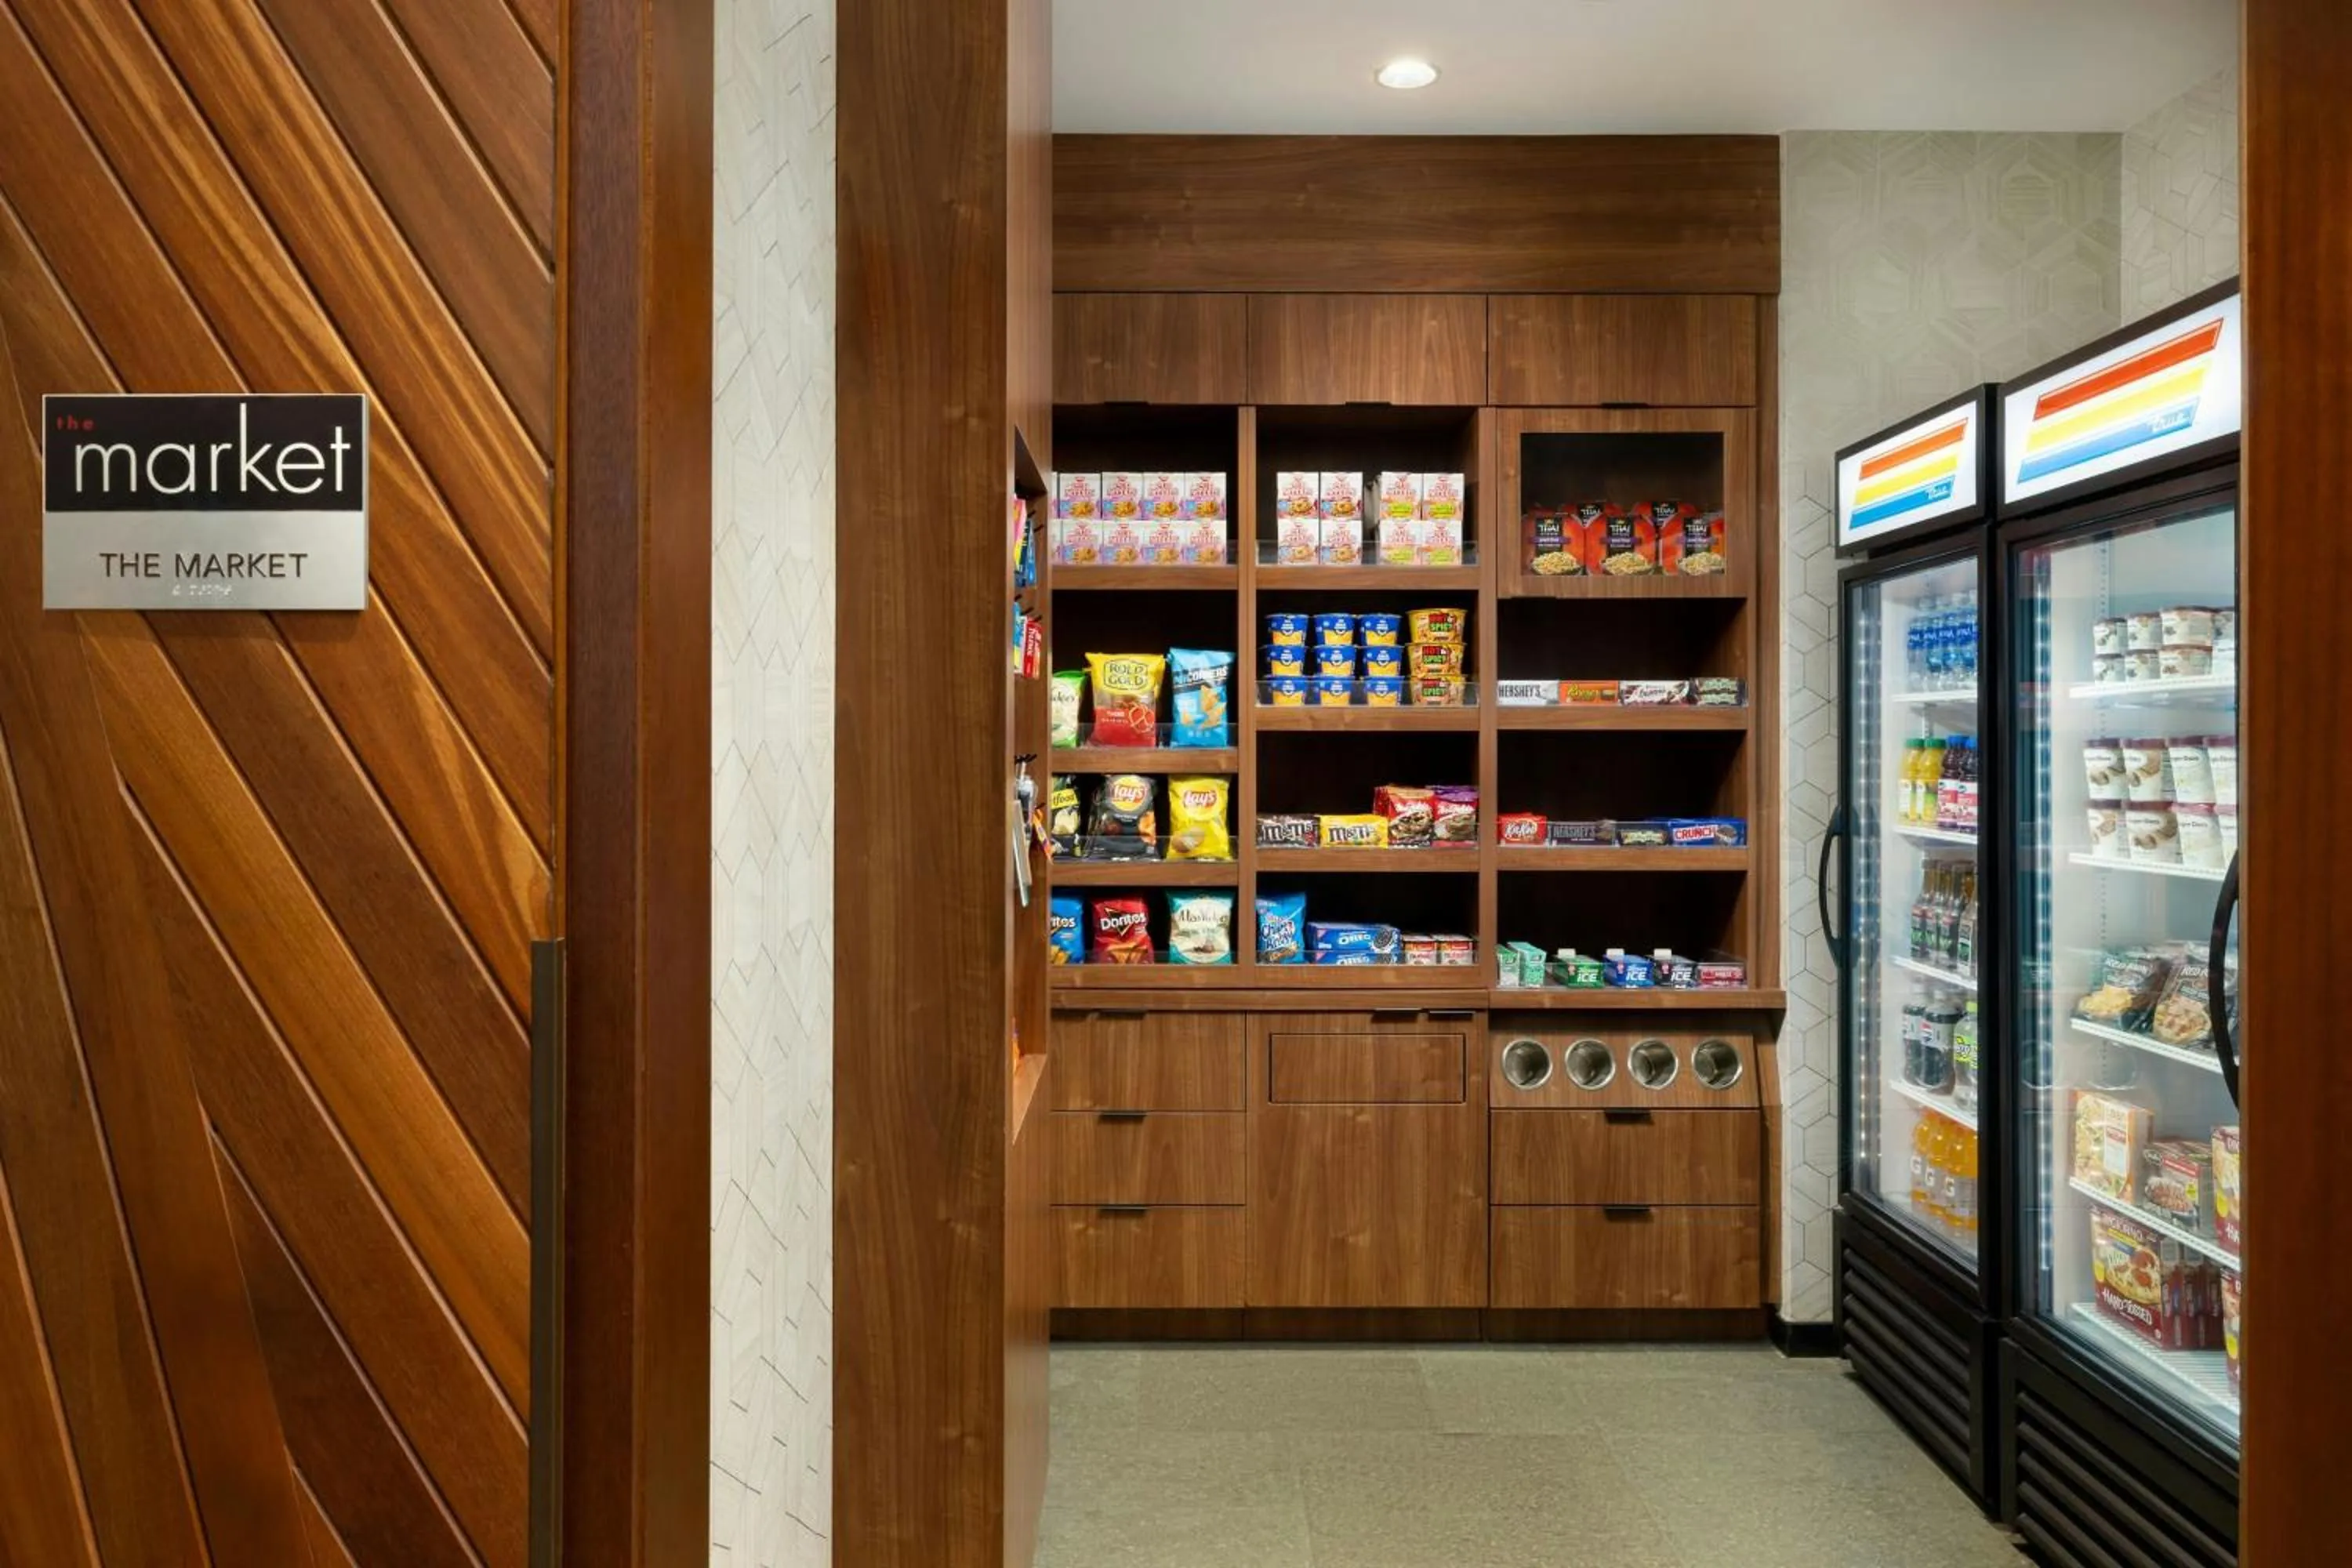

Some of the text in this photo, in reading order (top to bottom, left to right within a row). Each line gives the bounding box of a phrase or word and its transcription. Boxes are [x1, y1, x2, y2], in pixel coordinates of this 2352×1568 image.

[56, 415, 95, 431] the
[74, 402, 351, 494] market
[100, 553, 308, 579] THE MARKET
[1498, 684, 1541, 698] HERSHEY'S
[1675, 826, 1716, 840] CRUNCH
[1051, 916, 1076, 928] ritos
[1101, 912, 1146, 931] Doritos
